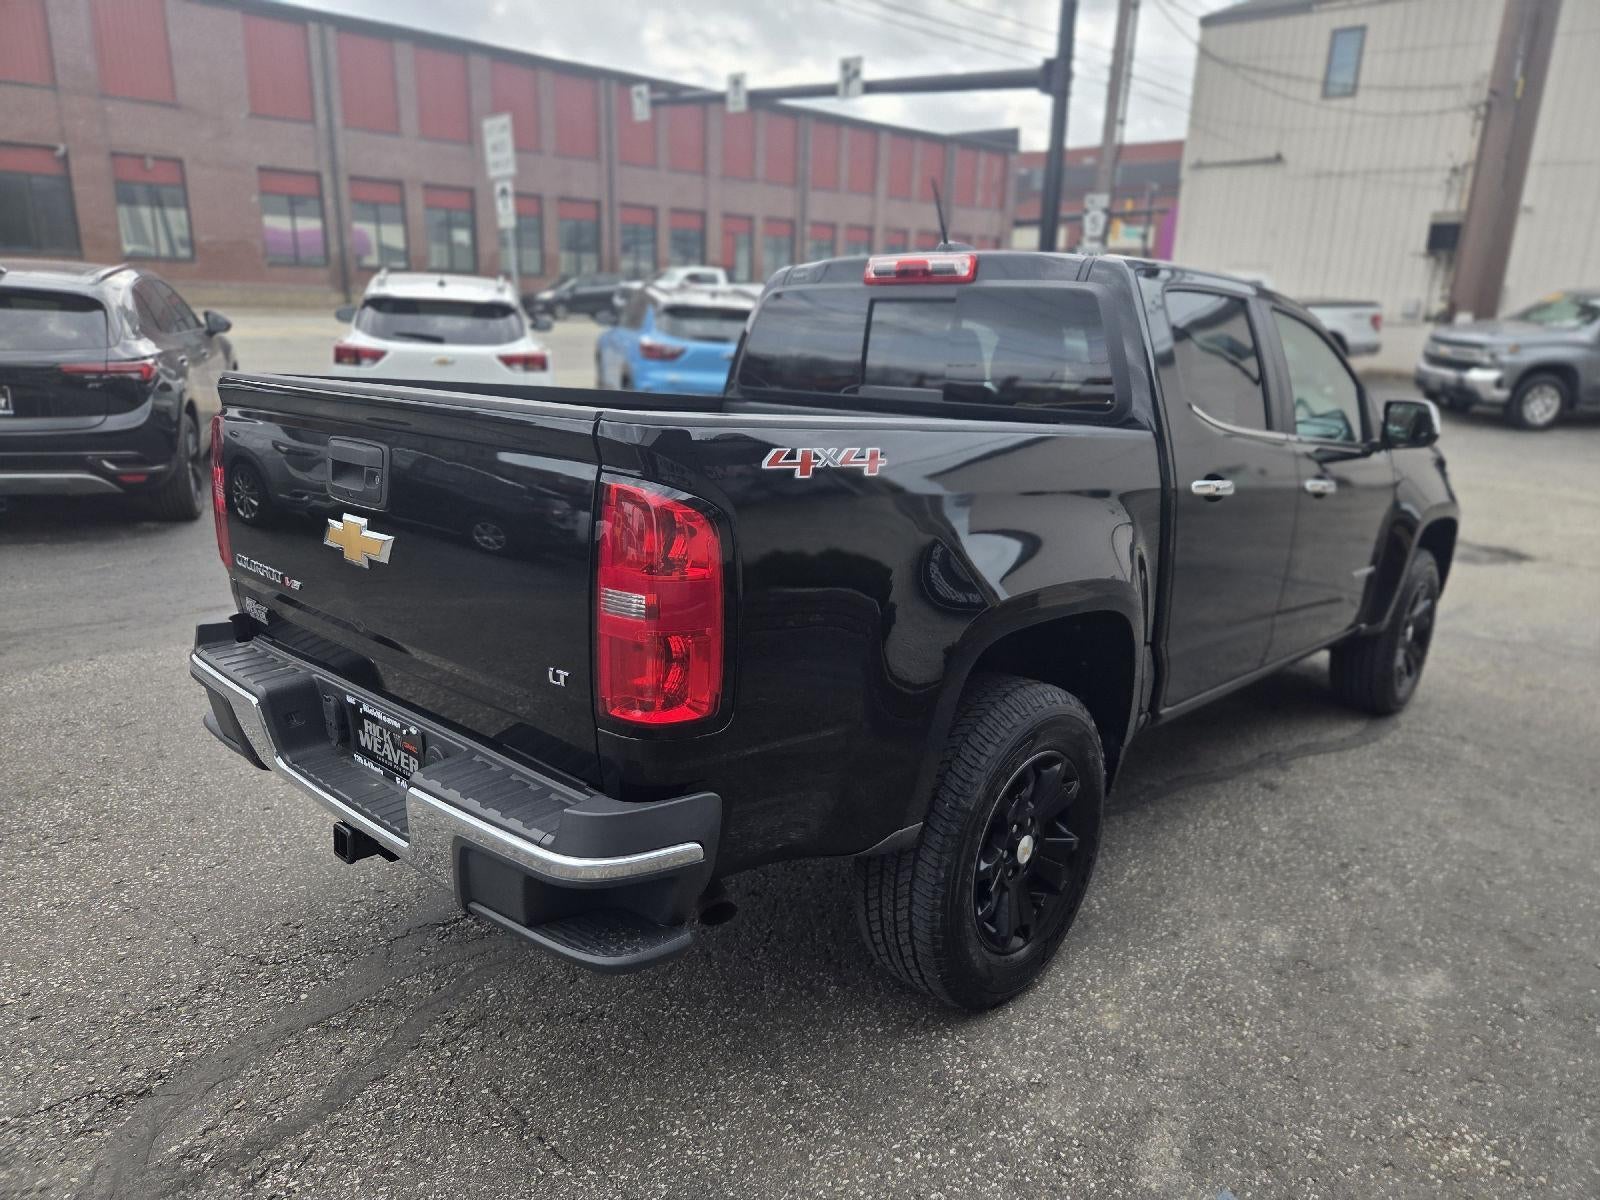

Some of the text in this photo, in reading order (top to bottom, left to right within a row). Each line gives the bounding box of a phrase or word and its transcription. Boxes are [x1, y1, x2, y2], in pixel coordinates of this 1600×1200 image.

[236, 553, 283, 583] COLORADO
[548, 667, 570, 687] LT
[363, 718, 391, 744] RICK
[358, 729, 419, 772] WEAVER
